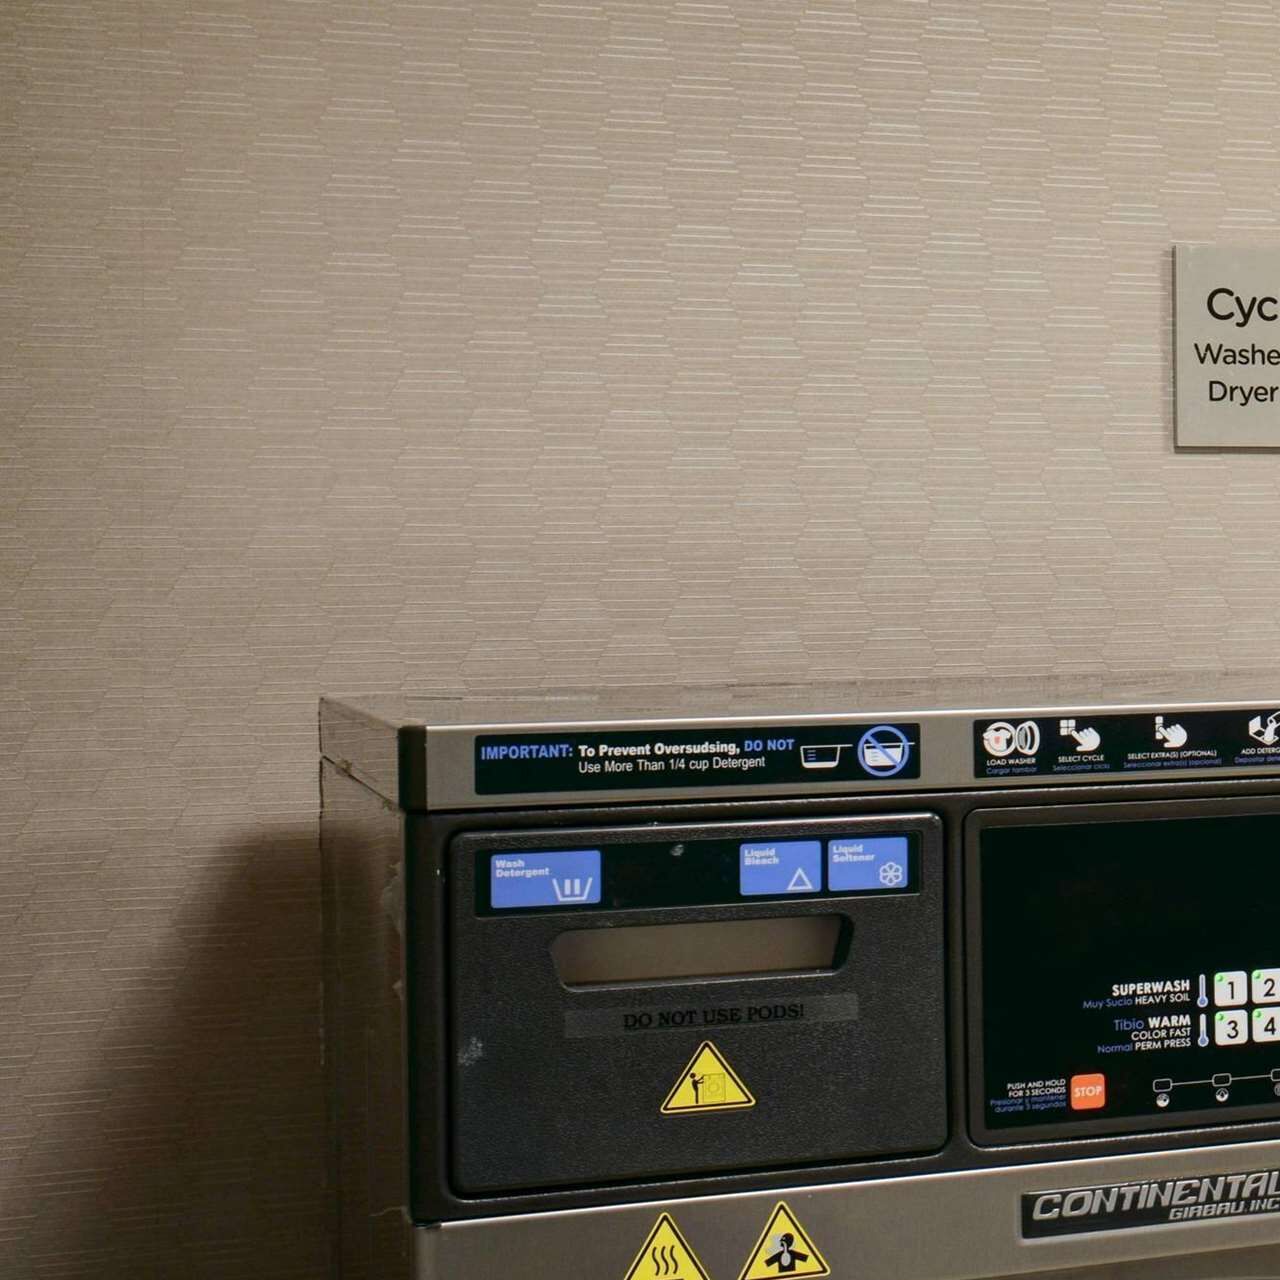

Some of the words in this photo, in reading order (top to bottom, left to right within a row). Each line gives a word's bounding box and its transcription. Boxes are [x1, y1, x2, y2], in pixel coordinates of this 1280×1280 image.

[1208, 381, 1278, 407] Dryer
[481, 744, 574, 761] IMPORTANT:
[578, 745, 596, 757] To
[599, 743, 651, 758] Prevent
[654, 741, 741, 758] Oversudsing,
[744, 739, 763, 752] DO
[767, 738, 794, 752] NOT
[578, 760, 600, 773] Use
[604, 760, 633, 773] More
[637, 758, 666, 772] Than
[669, 758, 686, 771] 1/4
[689, 760, 710, 773] cup
[713, 756, 765, 770] Detergent
[1008, 757, 1036, 766] WASHER
[1058, 755, 1081, 763] SELECT
[1082, 754, 1105, 762] CYCLE
[744, 848, 776, 860] Liquid
[833, 844, 864, 855] Liquid
[744, 856, 779, 866] Bleach
[833, 852, 875, 862] Softener
[496, 860, 525, 869] Wash
[496, 867, 549, 878] Detergent
[1112, 979, 1190, 997] SUPERWASH
[1227, 981, 1235, 1000] 1
[1263, 978, 1276, 998] 2
[1135, 996, 1168, 1005] HEAVY
[1169, 993, 1190, 1003] SOIL
[623, 1013, 653, 1029] DO
[657, 1010, 697, 1027] NOT
[703, 1007, 741, 1024] USE
[747, 1003, 805, 1021] PODS!
[1114, 1018, 1144, 1031] Tibio
[1149, 1014, 1191, 1028] WARM
[1226, 1020, 1239, 1040] 3
[1263, 1016, 1276, 1036] 4
[1131, 1030, 1167, 1041] COLOR
[1170, 1028, 1191, 1038] FAST
[1135, 1041, 1162, 1051] PERM
[1164, 1038, 1191, 1049] PRESS
[1074, 1086, 1102, 1098] STOP
